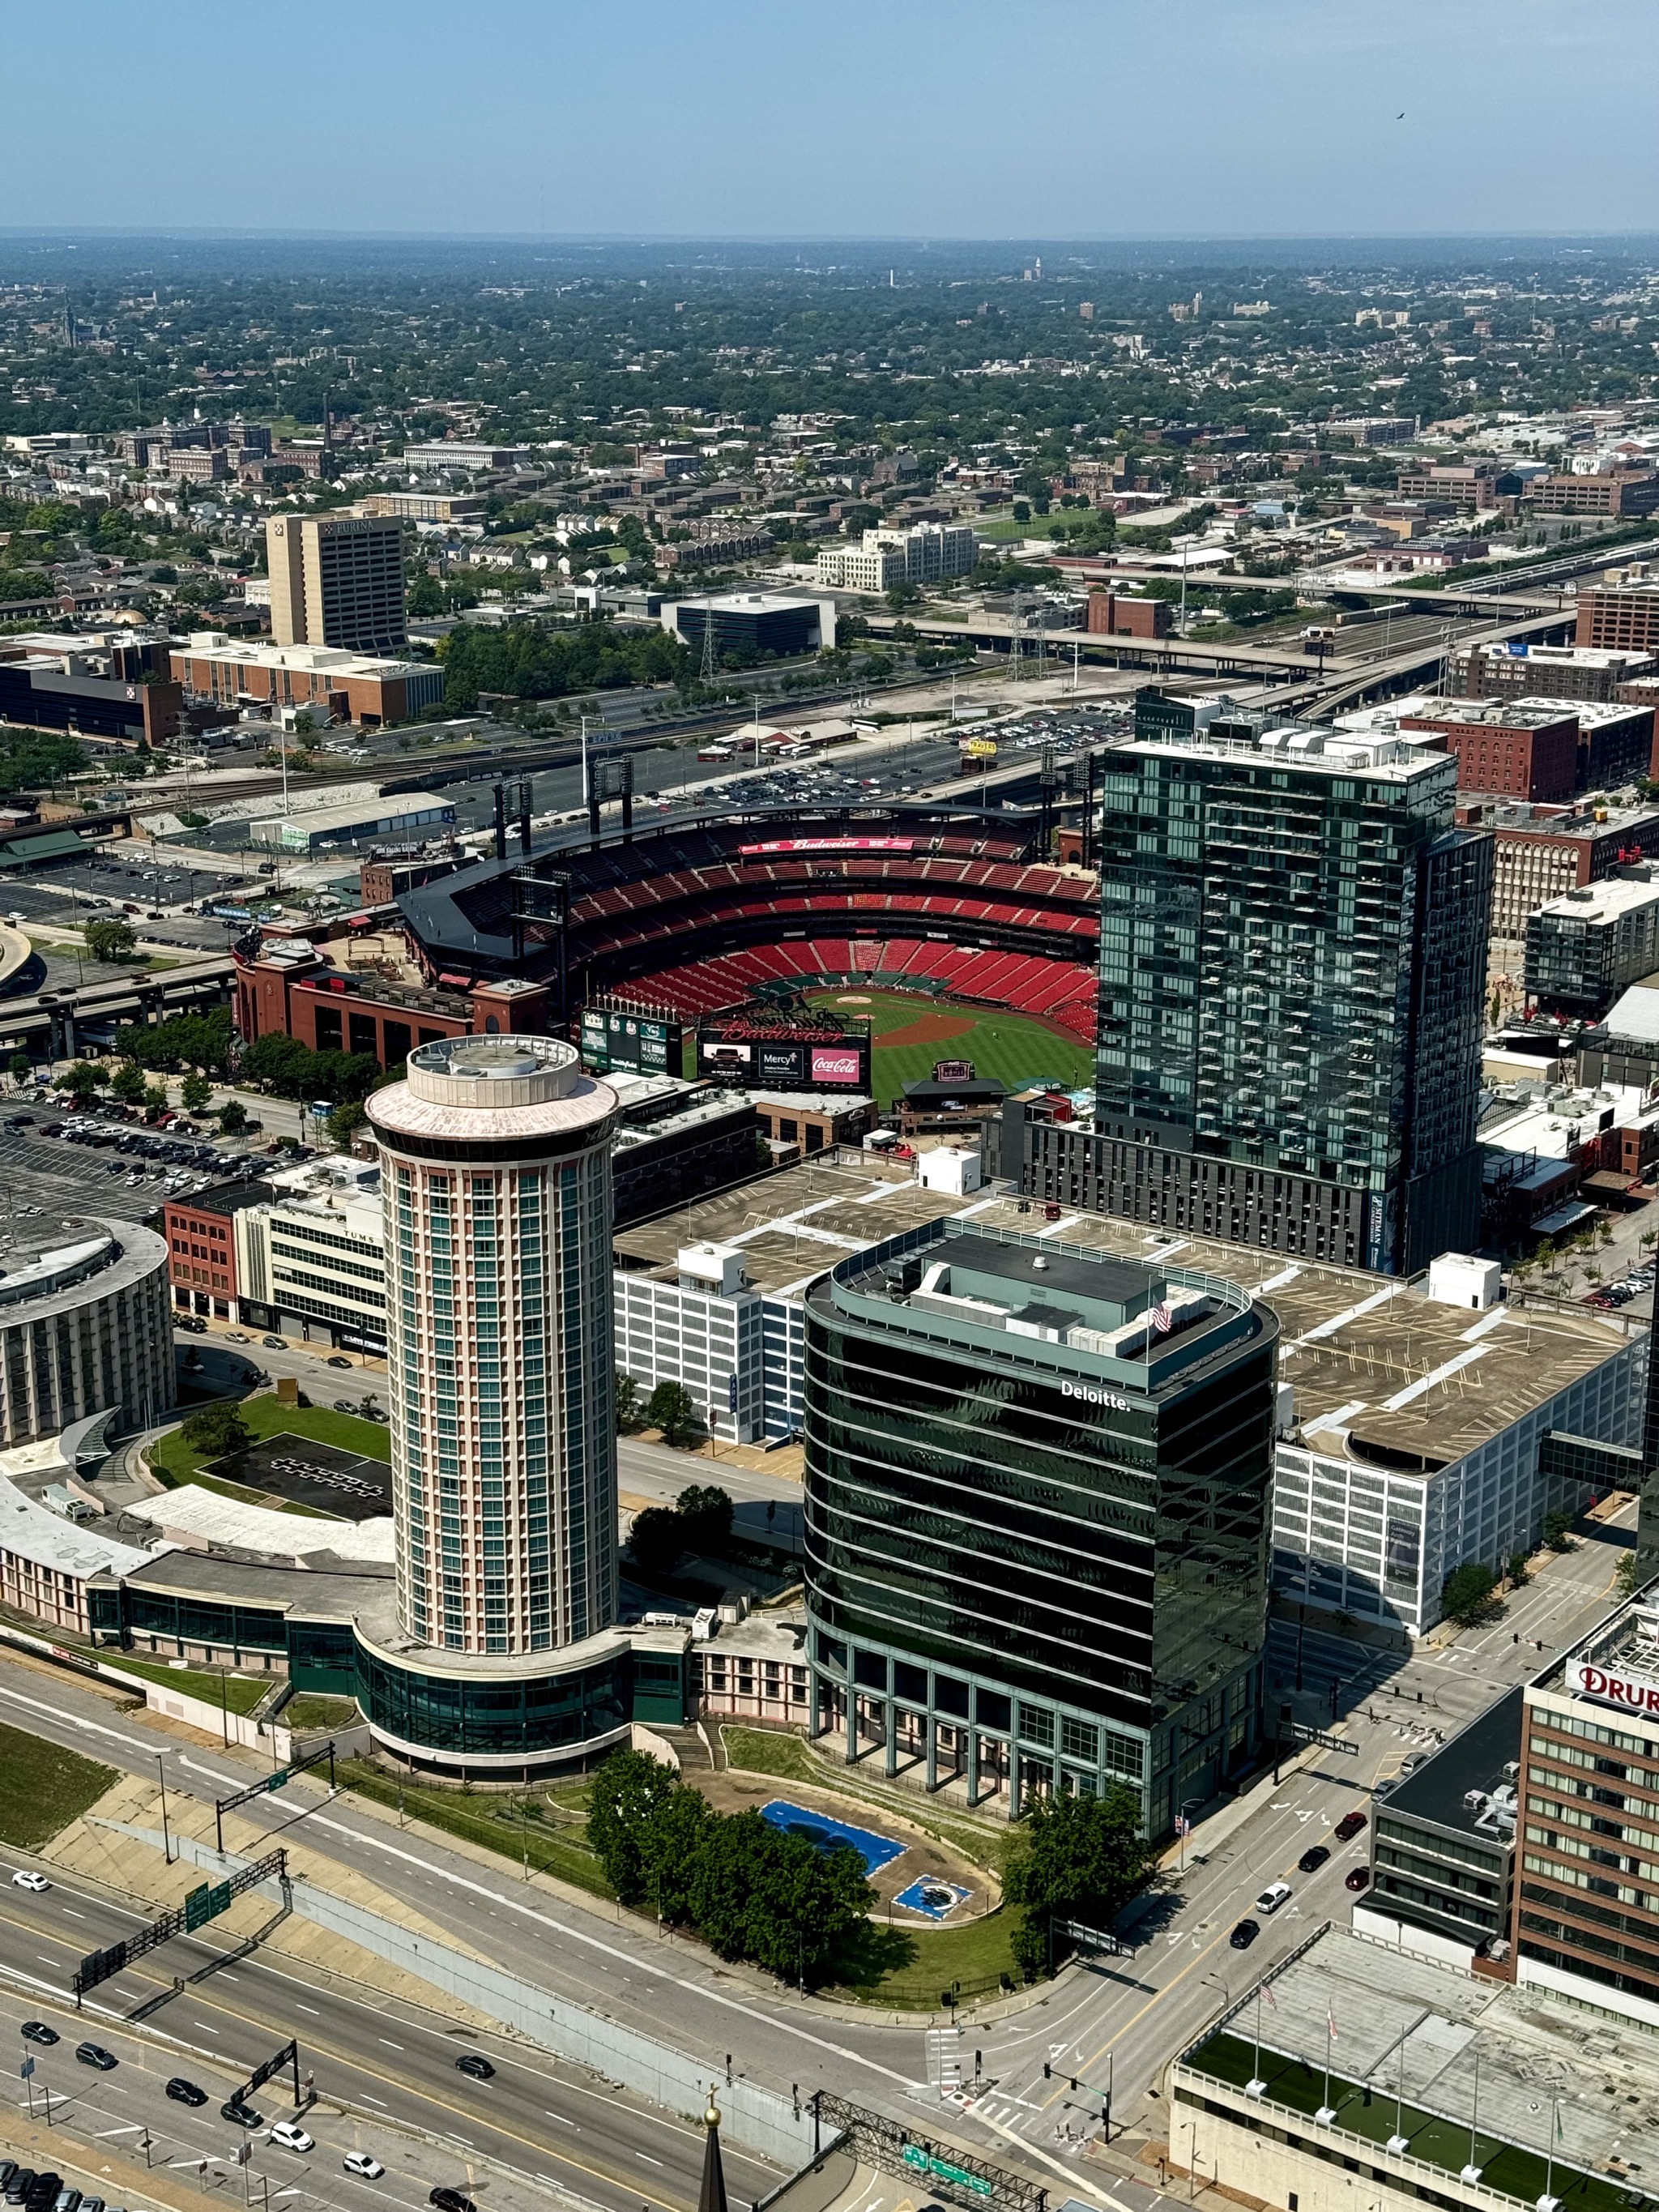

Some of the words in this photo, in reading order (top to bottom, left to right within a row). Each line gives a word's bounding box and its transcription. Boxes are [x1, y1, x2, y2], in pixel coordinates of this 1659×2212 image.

[337, 520, 373, 533] PURINA
[790, 839, 859, 849] Budweiser
[717, 1019, 845, 1042] Budweiser
[764, 1054, 791, 1065] Mercy
[812, 1057, 858, 1074] Coca-Cola
[1375, 1207, 1383, 1245] SITEMAN
[343, 1230, 374, 1243] TUMS
